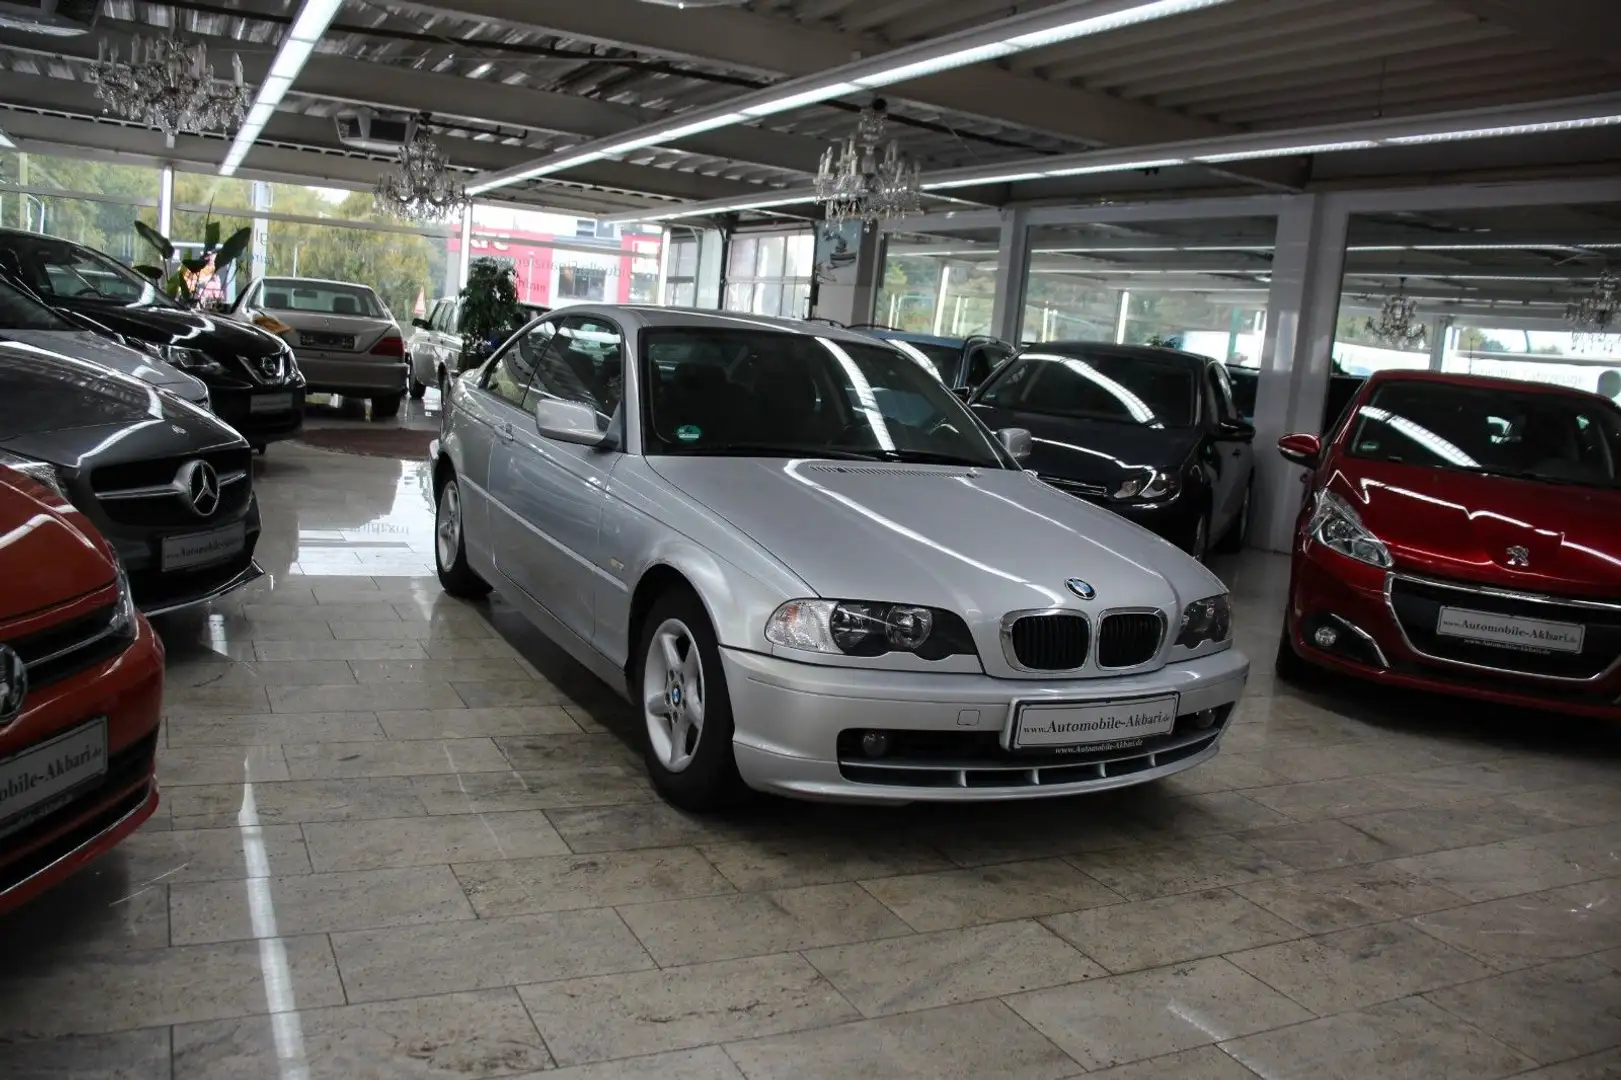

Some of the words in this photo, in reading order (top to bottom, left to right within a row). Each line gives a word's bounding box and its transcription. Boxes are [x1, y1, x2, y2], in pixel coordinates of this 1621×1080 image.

[1443, 619, 1577, 643] www.Automobile-Akbari.de
[1023, 711, 1170, 734] www.Automobile-Akbari.de
[1055, 739, 1143, 754] www.Automobile-Akbari.de
